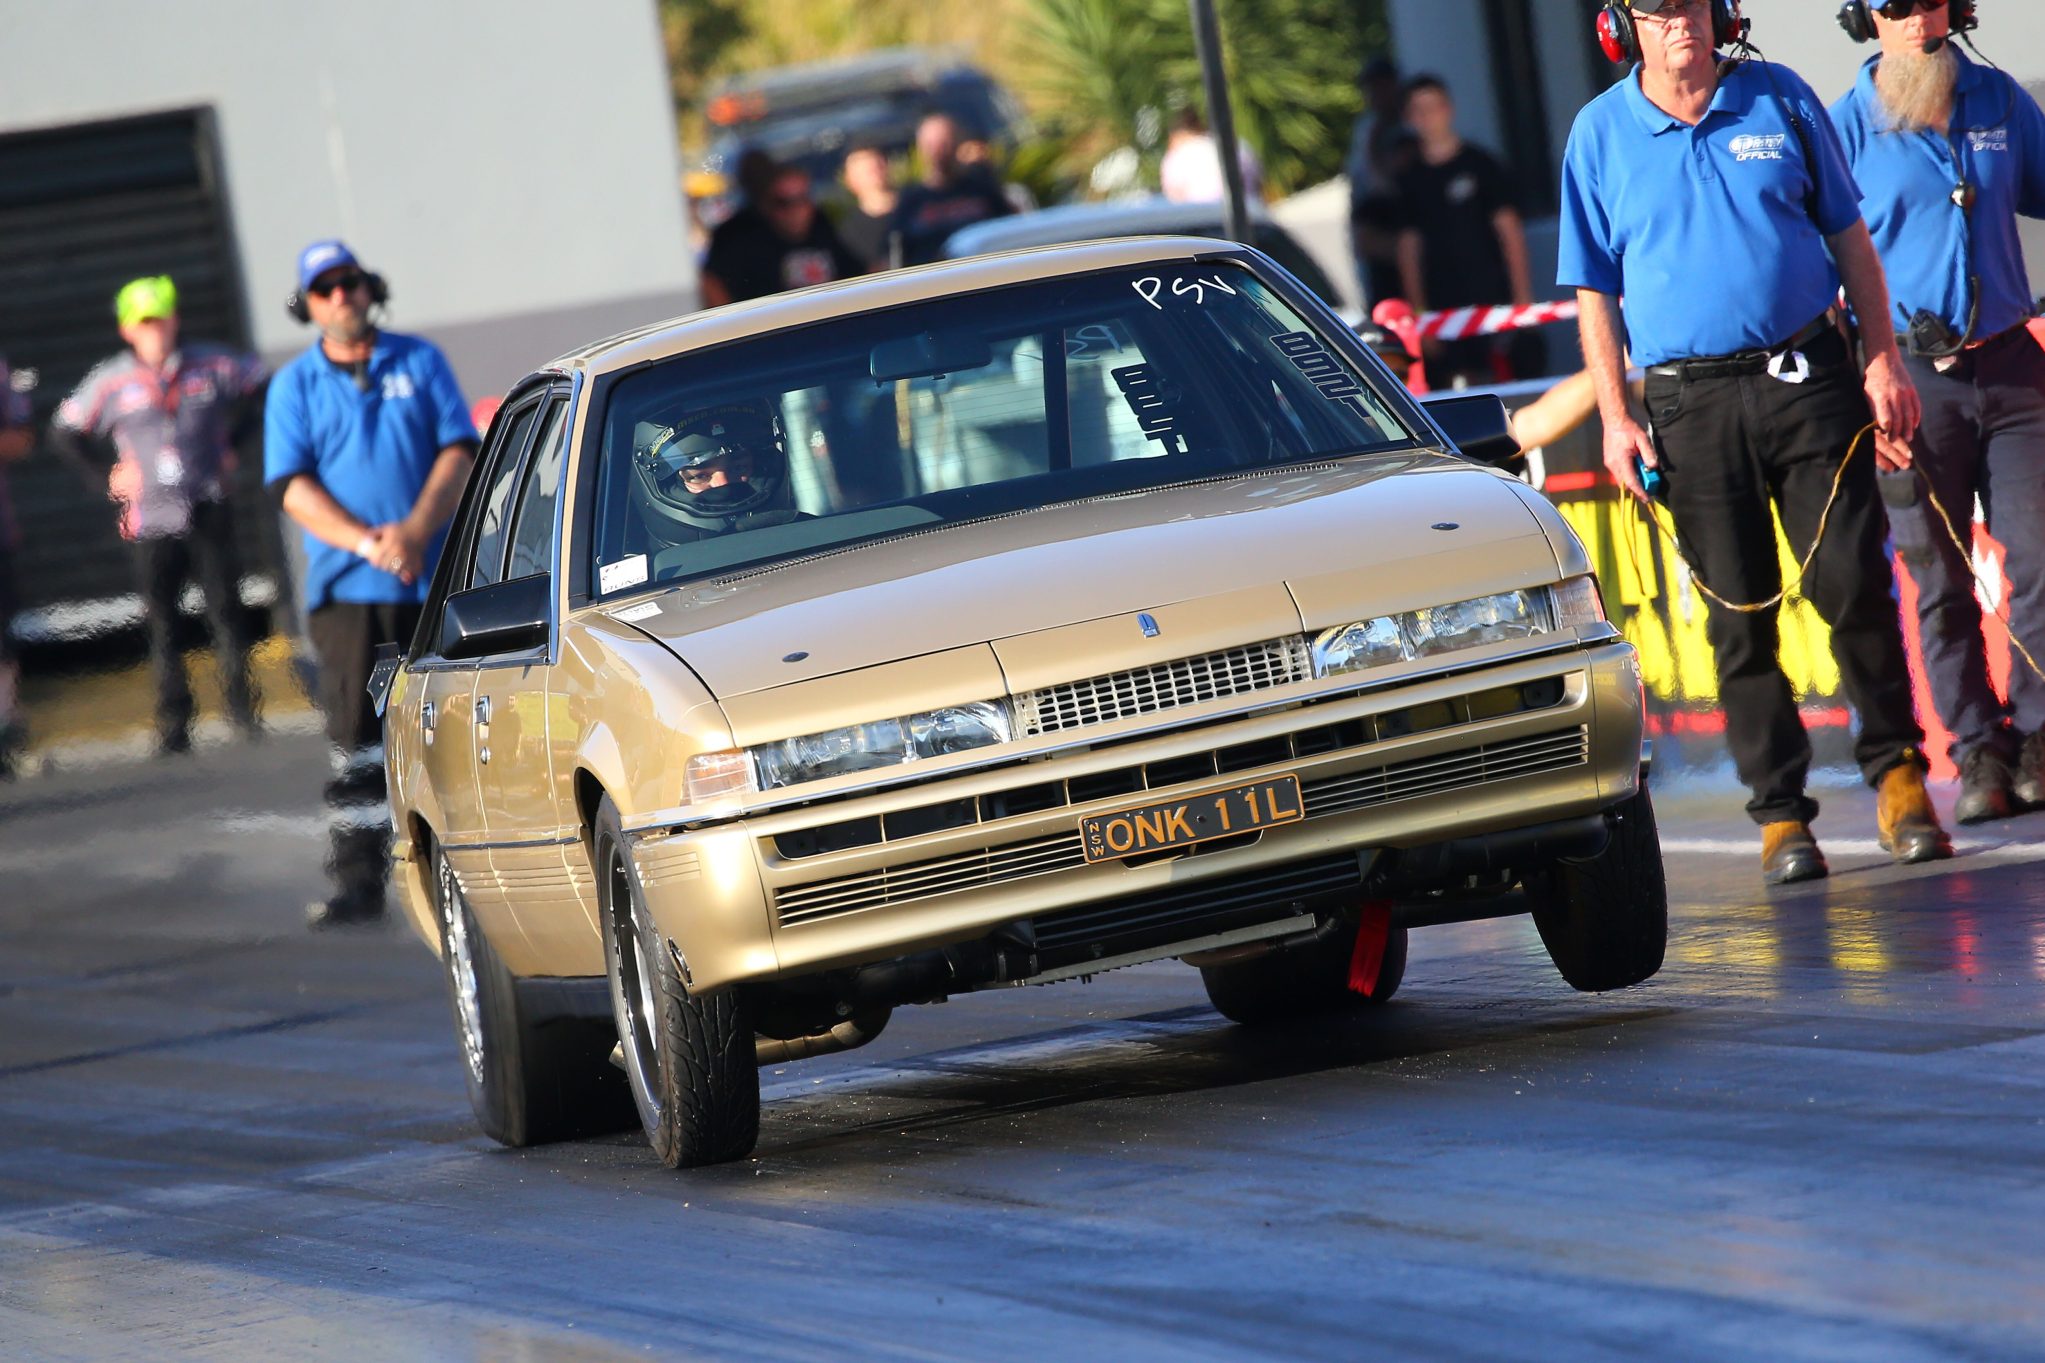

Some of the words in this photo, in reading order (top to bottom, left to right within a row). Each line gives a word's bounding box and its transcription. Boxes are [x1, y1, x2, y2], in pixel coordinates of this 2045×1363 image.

[1736, 151, 1782, 161] OFFICIAL
[1089, 822, 1105, 857] NSW
[1106, 805, 1195, 851] ONK
